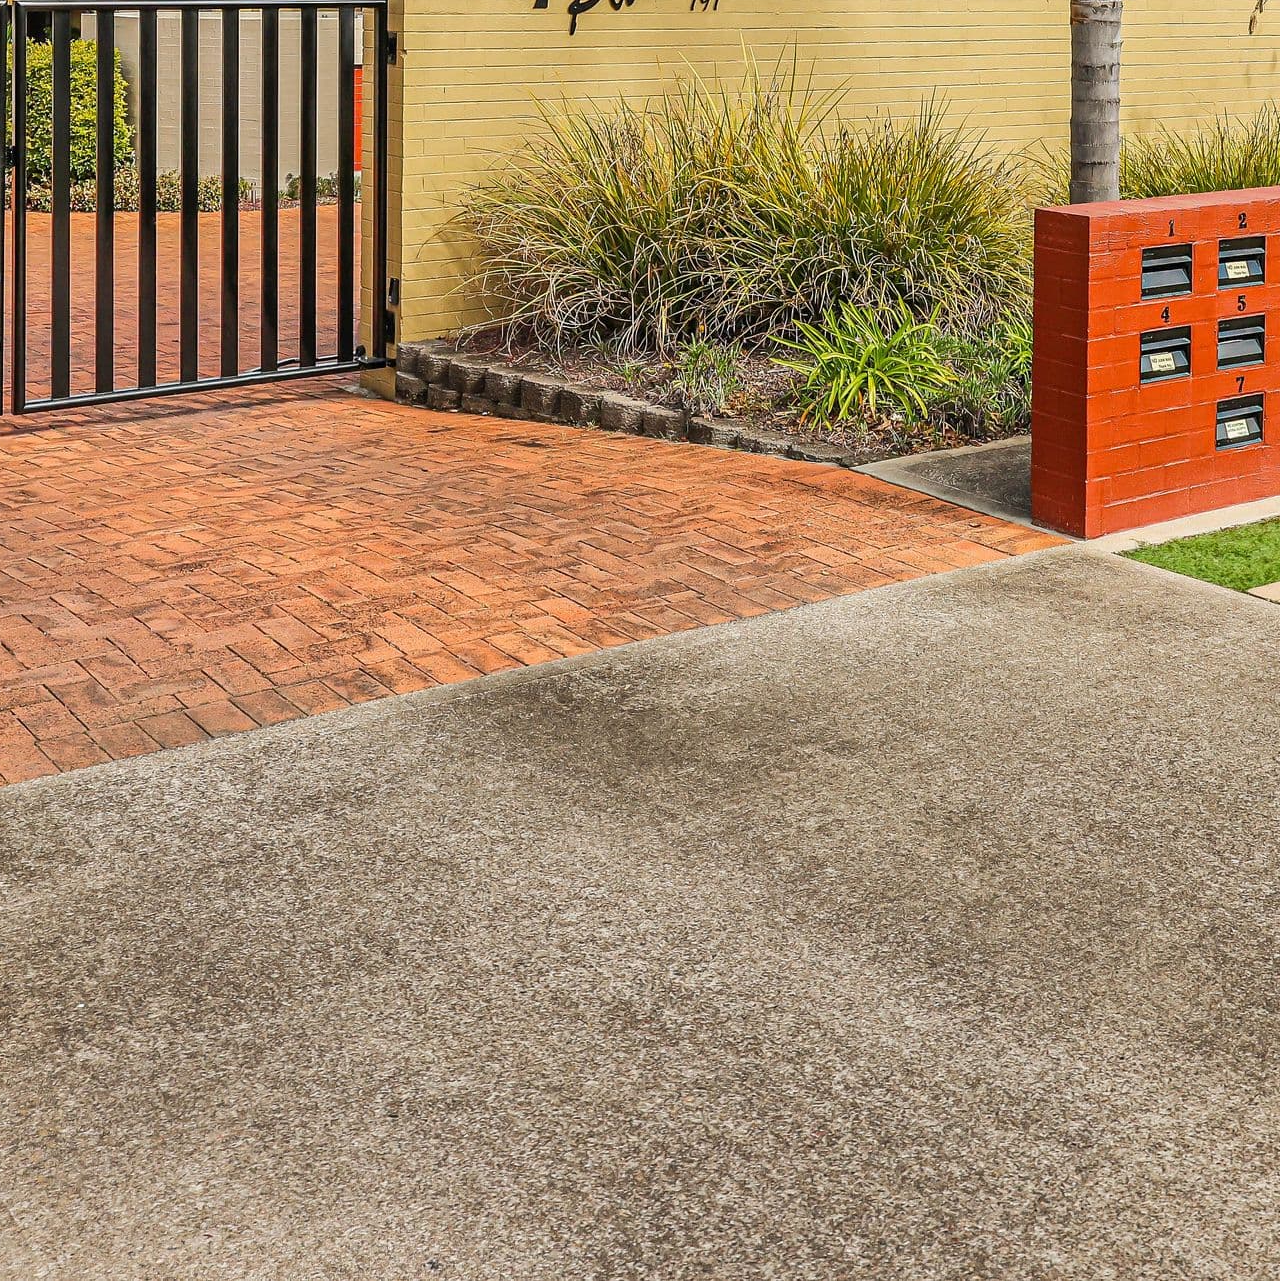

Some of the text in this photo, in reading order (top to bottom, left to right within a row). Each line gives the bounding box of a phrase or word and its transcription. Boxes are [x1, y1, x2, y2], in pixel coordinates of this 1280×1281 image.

[1168, 219, 1175, 237] 1
[1238, 212, 1248, 230] 2
[1237, 294, 1247, 312] 5
[1160, 306, 1170, 323] 4
[1235, 376, 1245, 393] 7
